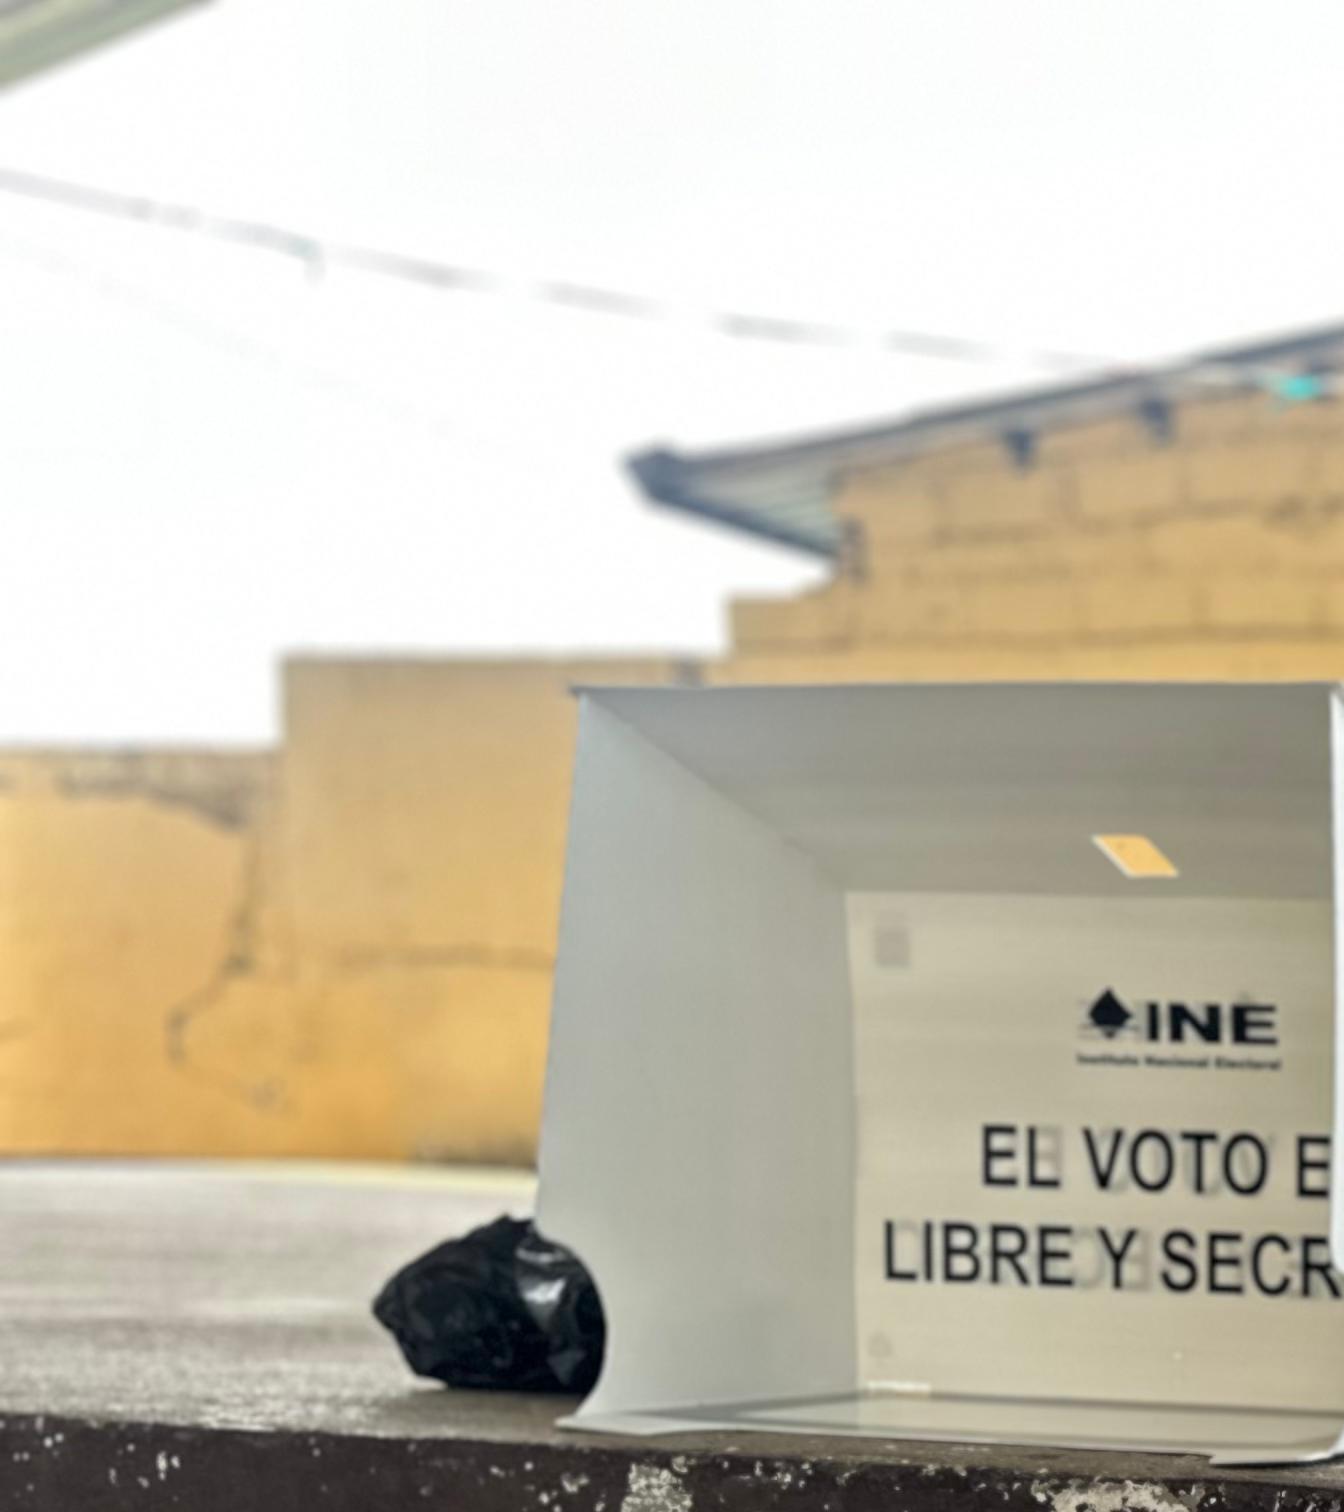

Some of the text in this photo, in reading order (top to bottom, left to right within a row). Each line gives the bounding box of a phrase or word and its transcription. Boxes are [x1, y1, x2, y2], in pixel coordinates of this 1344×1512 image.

[1146, 1002, 1278, 1045] INE
[981, 1124, 1332, 1200] EL VOTO E
[884, 1220, 1073, 1288] LIBRE
[1098, 1227, 1137, 1290] Y
